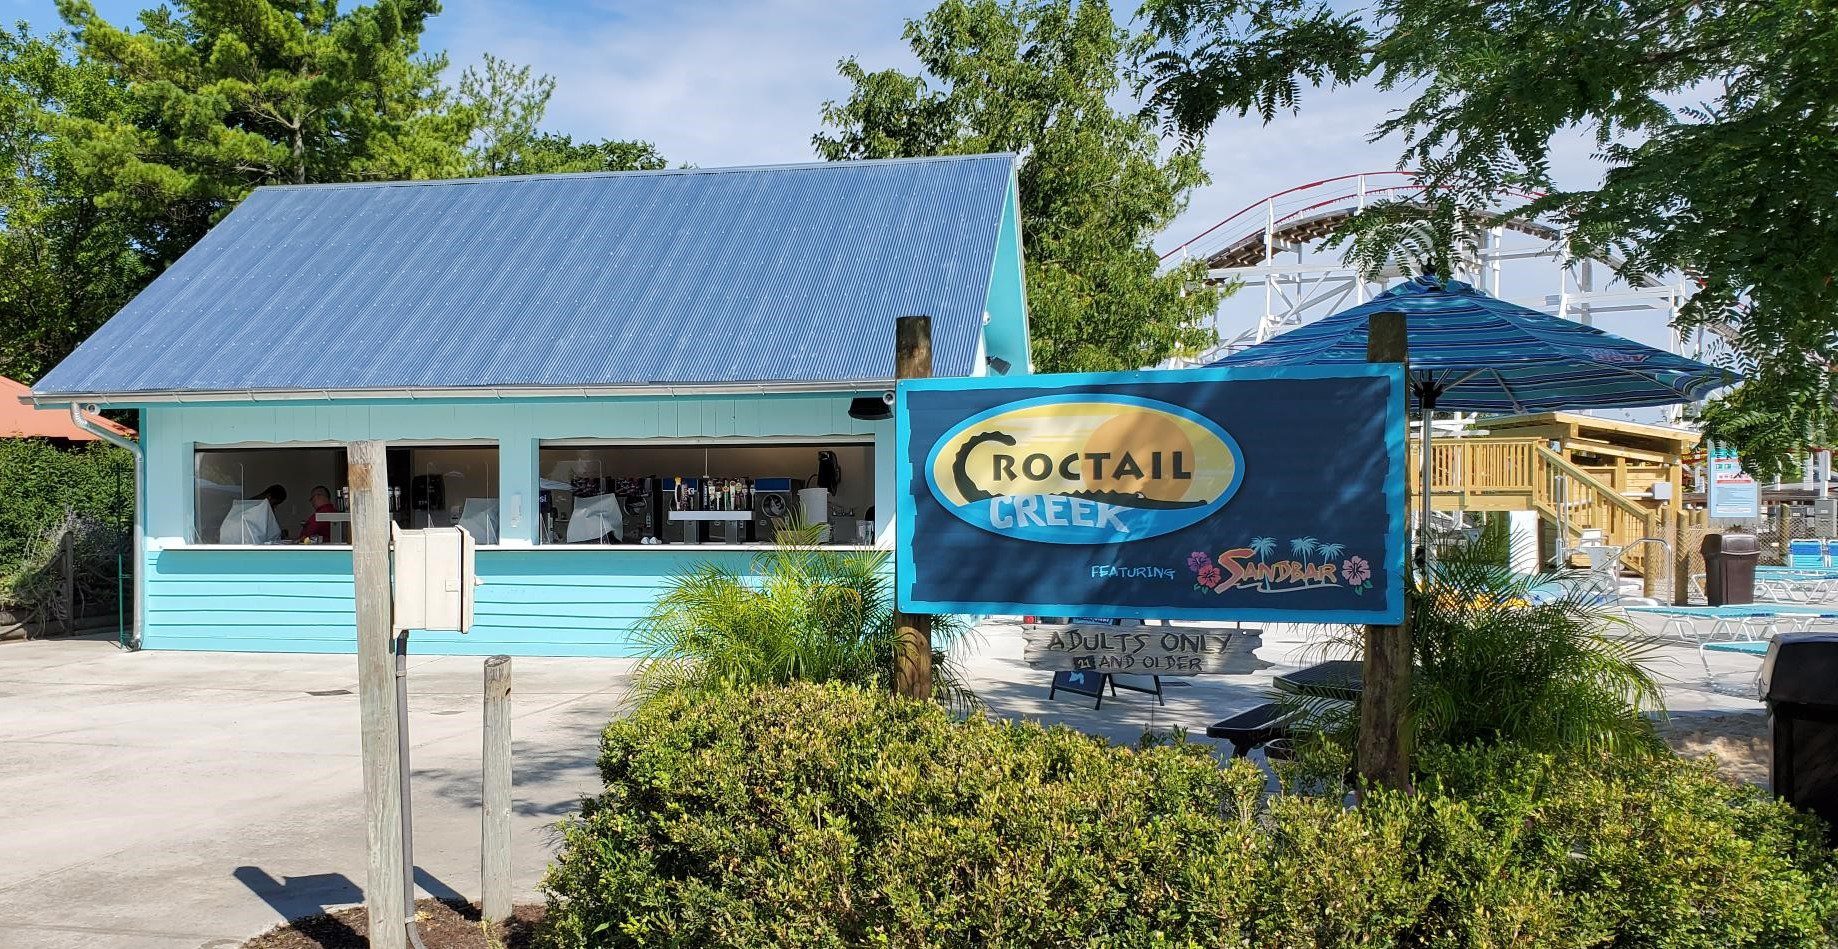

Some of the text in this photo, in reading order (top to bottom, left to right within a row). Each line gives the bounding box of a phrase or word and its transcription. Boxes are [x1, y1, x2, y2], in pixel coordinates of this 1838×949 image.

[952, 431, 1191, 503] CROCTAIL
[990, 494, 1130, 533] CREEK
[1091, 565, 1175, 580] FEATURING
[1213, 548, 1337, 594] SANDBAR
[1047, 629, 1233, 654] ADULTS ONLY
[1099, 655, 1135, 669] AND
[1142, 656, 1203, 671] OLDER
